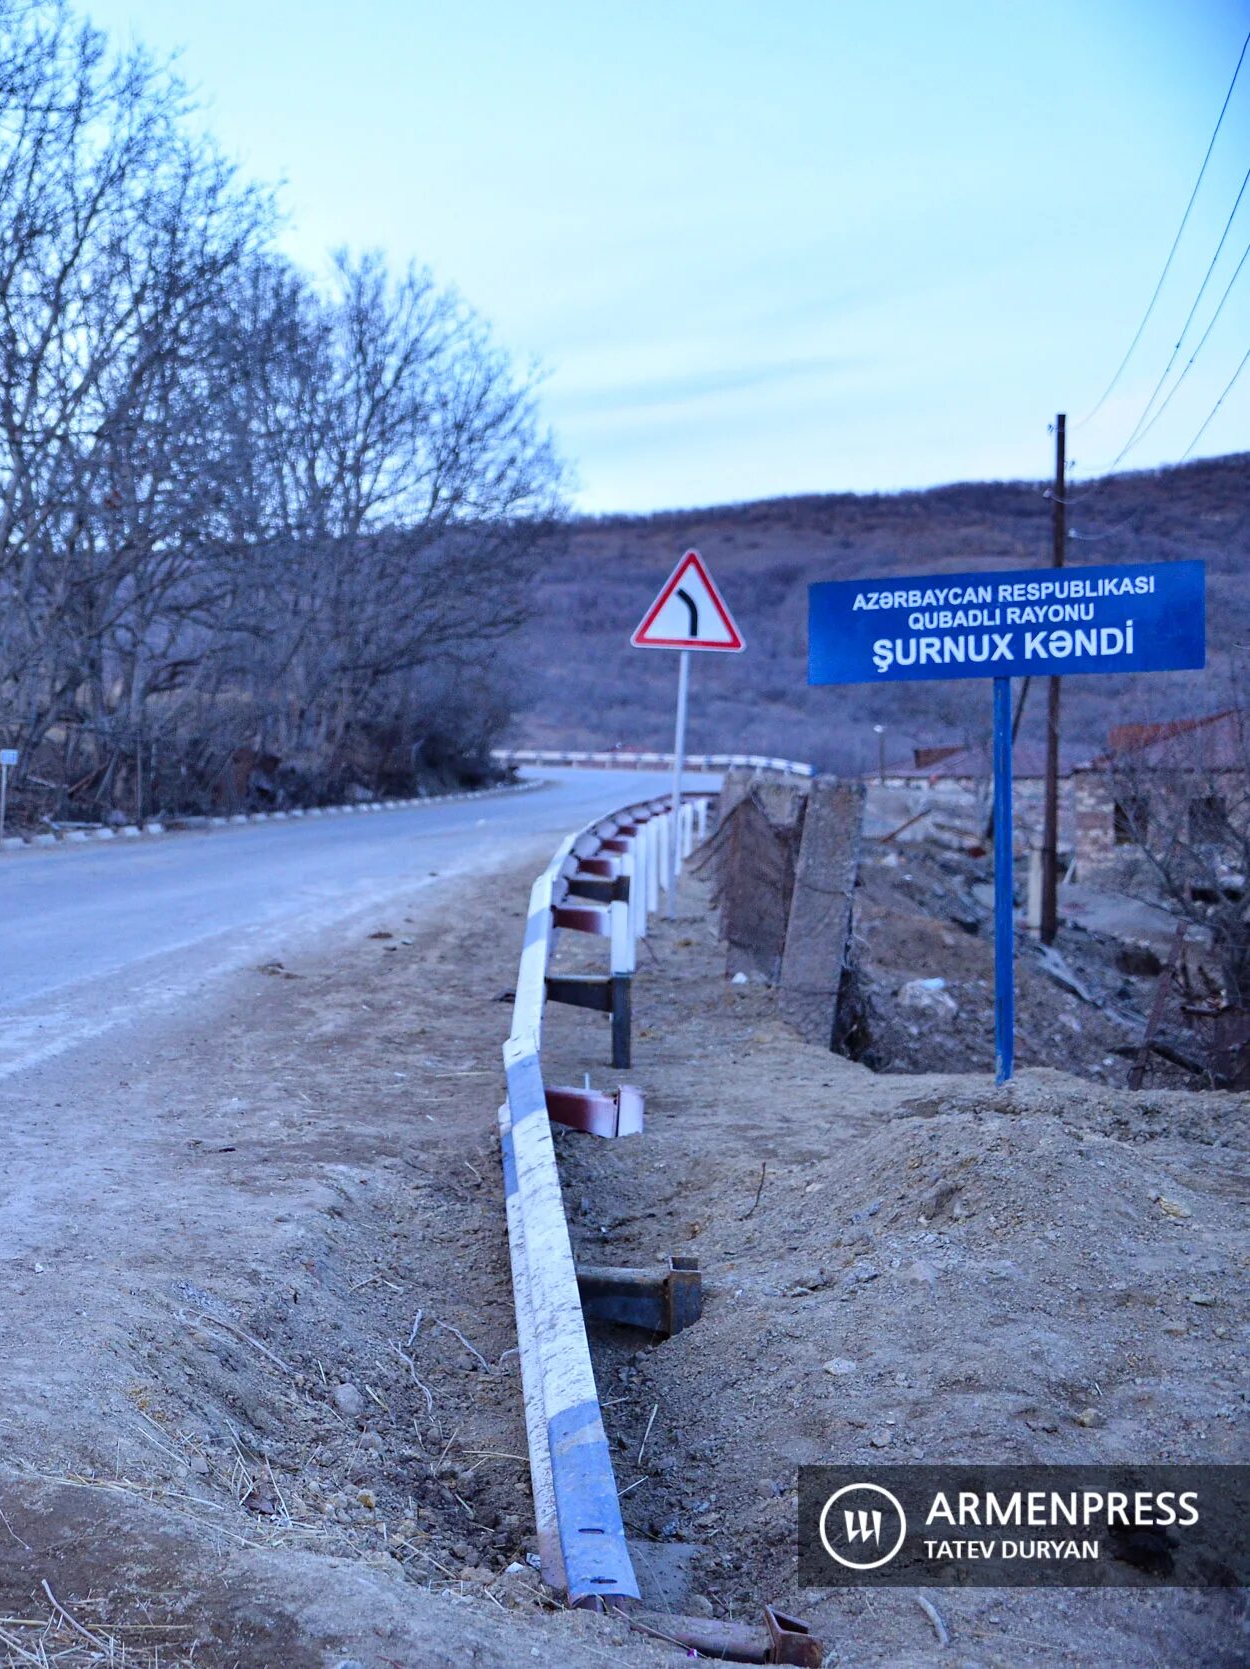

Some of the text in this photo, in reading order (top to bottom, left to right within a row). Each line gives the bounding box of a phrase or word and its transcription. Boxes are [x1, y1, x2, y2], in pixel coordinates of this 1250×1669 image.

[853, 575, 1155, 612] AZƏRBAYCAN RESPUBLIKASI
[908, 604, 1093, 629] QUBADLI RAYONU
[872, 619, 1133, 672] ŞURNUX KƏNDİ
